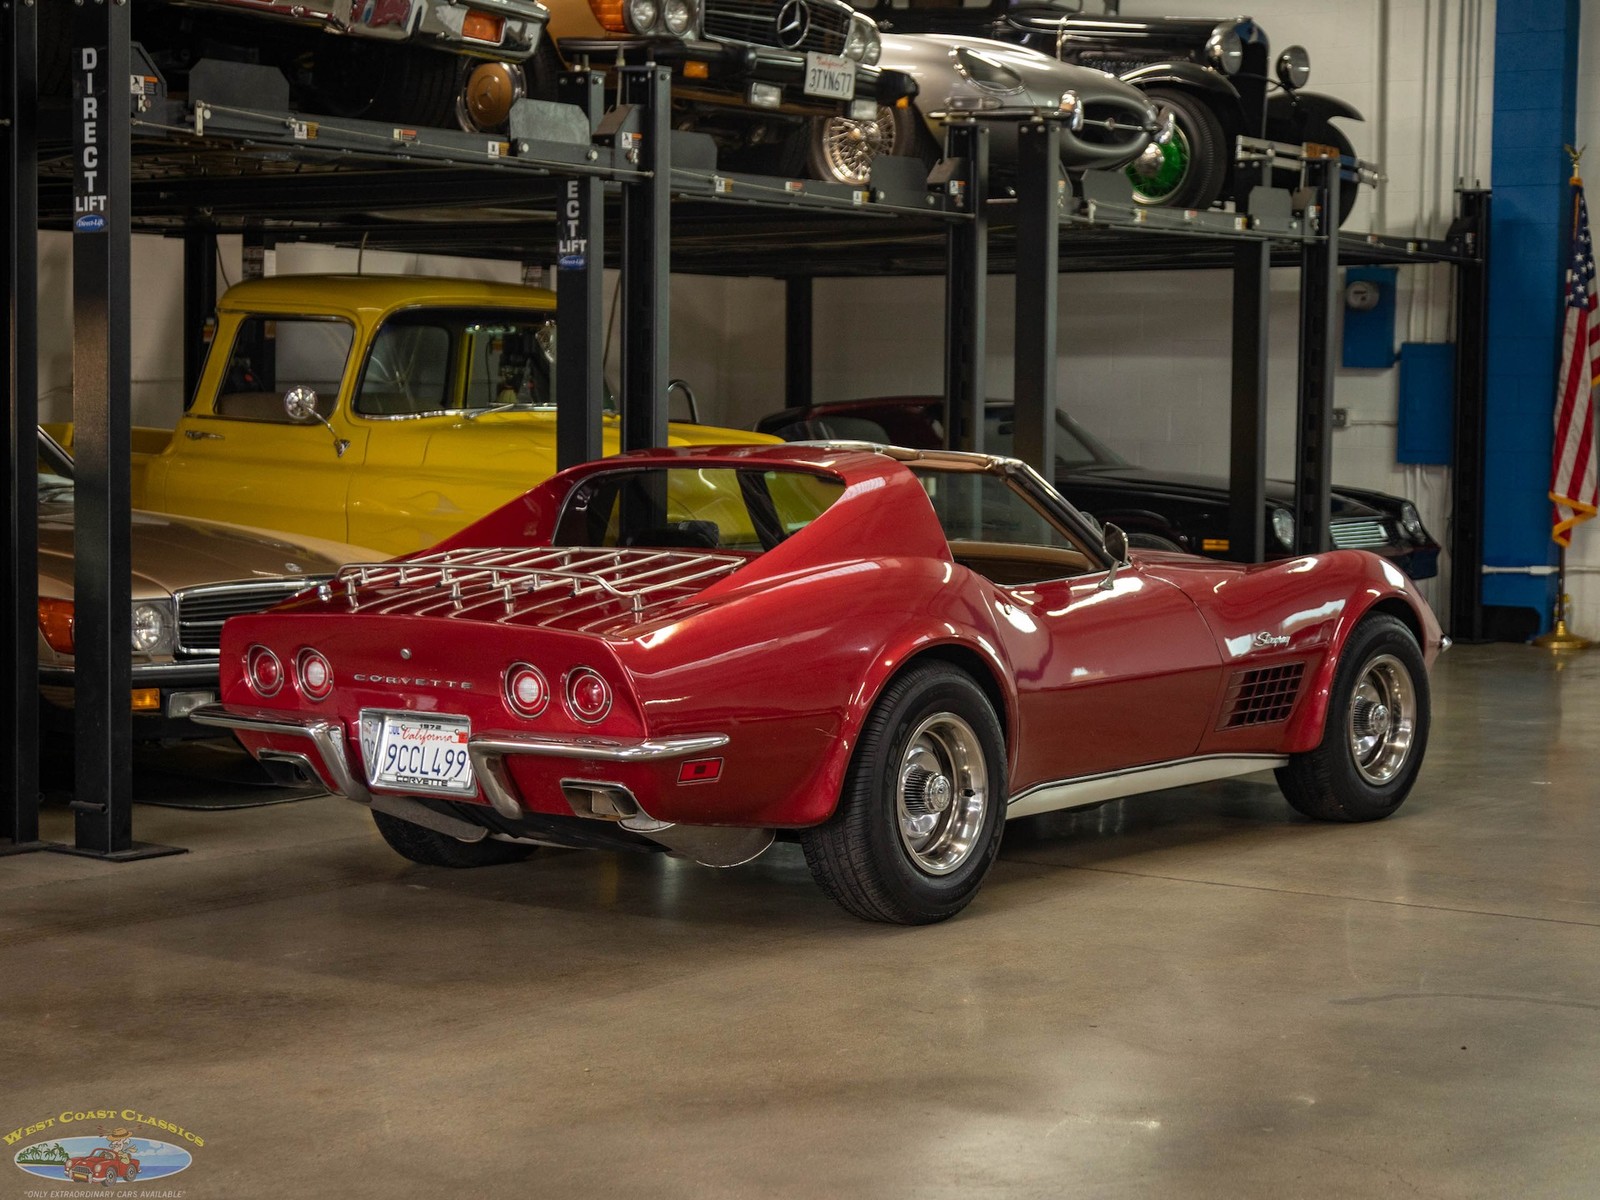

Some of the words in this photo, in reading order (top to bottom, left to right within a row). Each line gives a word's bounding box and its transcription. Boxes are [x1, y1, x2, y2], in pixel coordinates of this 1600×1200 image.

[809, 68, 852, 93] 3TYN677
[82, 47, 98, 193] DIRECT
[75, 195, 107, 212] LIFT
[559, 239, 587, 253] LIFT
[353, 673, 473, 689] CORVETTE
[402, 727, 454, 745] California
[385, 743, 467, 778] 9CCL499
[396, 775, 448, 787] CORVETTE
